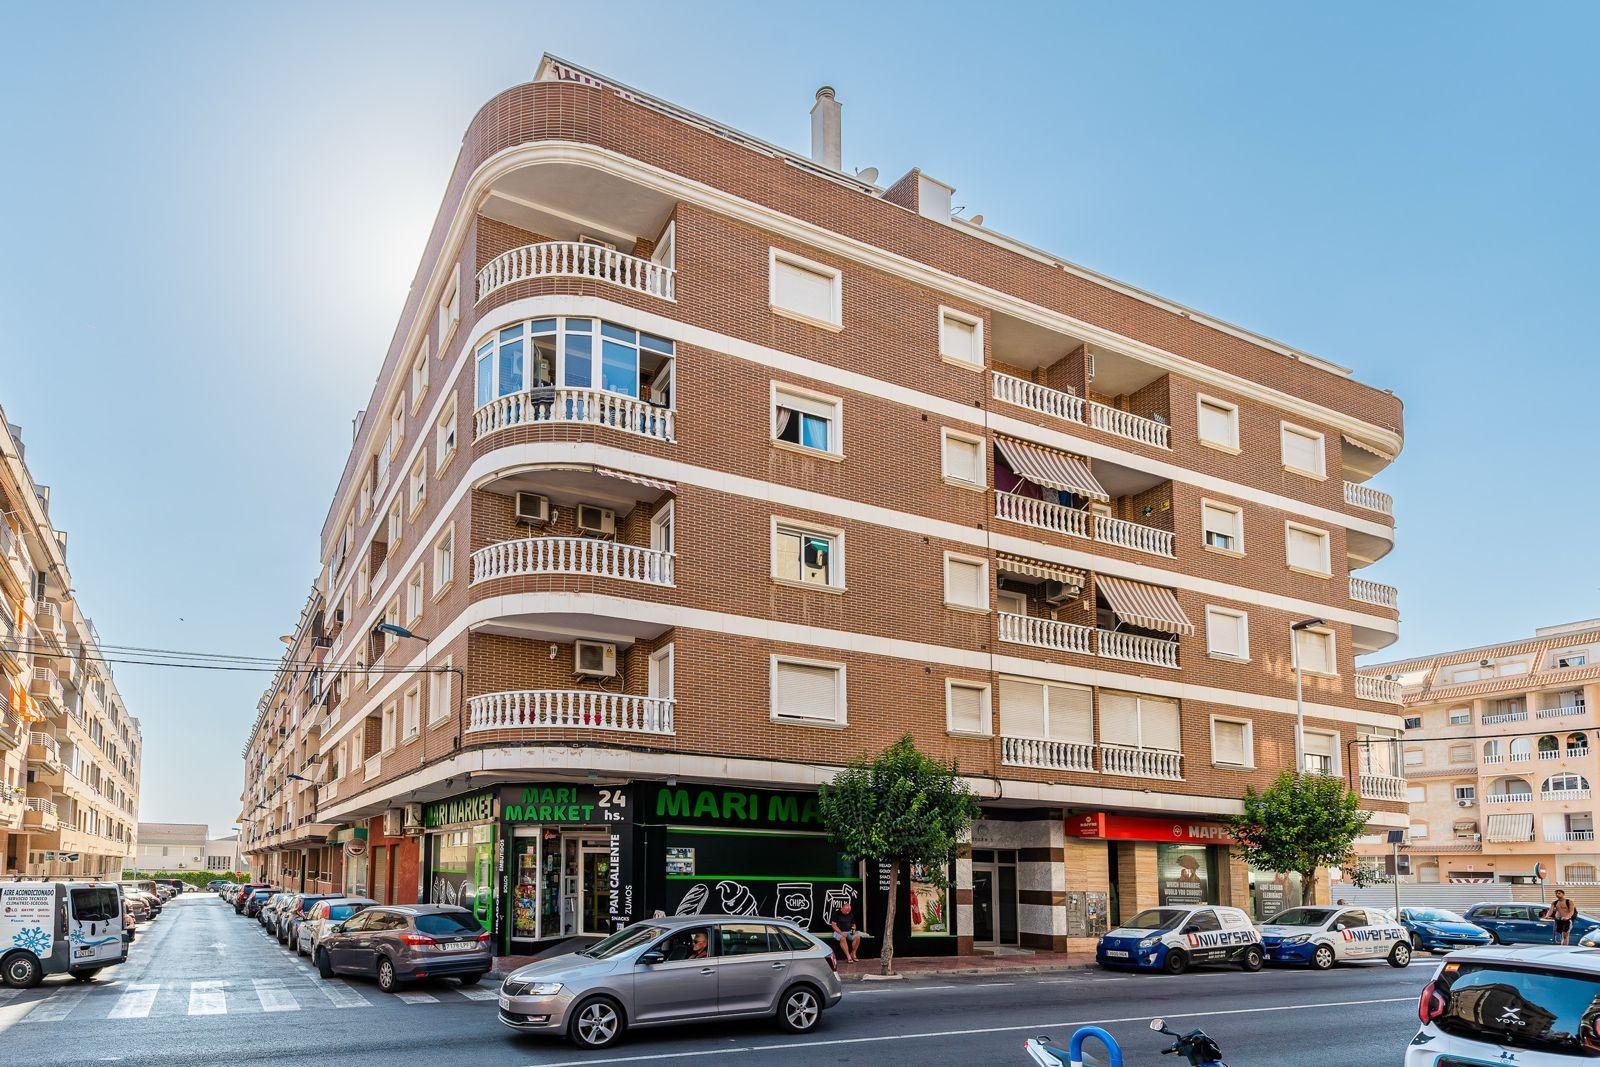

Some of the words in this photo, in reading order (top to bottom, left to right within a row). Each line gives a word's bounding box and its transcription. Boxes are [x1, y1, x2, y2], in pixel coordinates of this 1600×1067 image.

[522, 787, 577, 804] MARI
[598, 789, 626, 808] 24
[656, 788, 758, 821] MARI
[425, 802, 448, 828] MARI
[449, 793, 494, 824] MARKET
[505, 805, 595, 821] MARKET
[604, 809, 625, 821] hs.
[610, 834, 620, 888] CALIENTE
[609, 889, 619, 914] PAN
[625, 885, 633, 915] ZUMOS
[789, 898, 806, 908] CHIPS
[1495, 1017, 1526, 1026] YOYO
